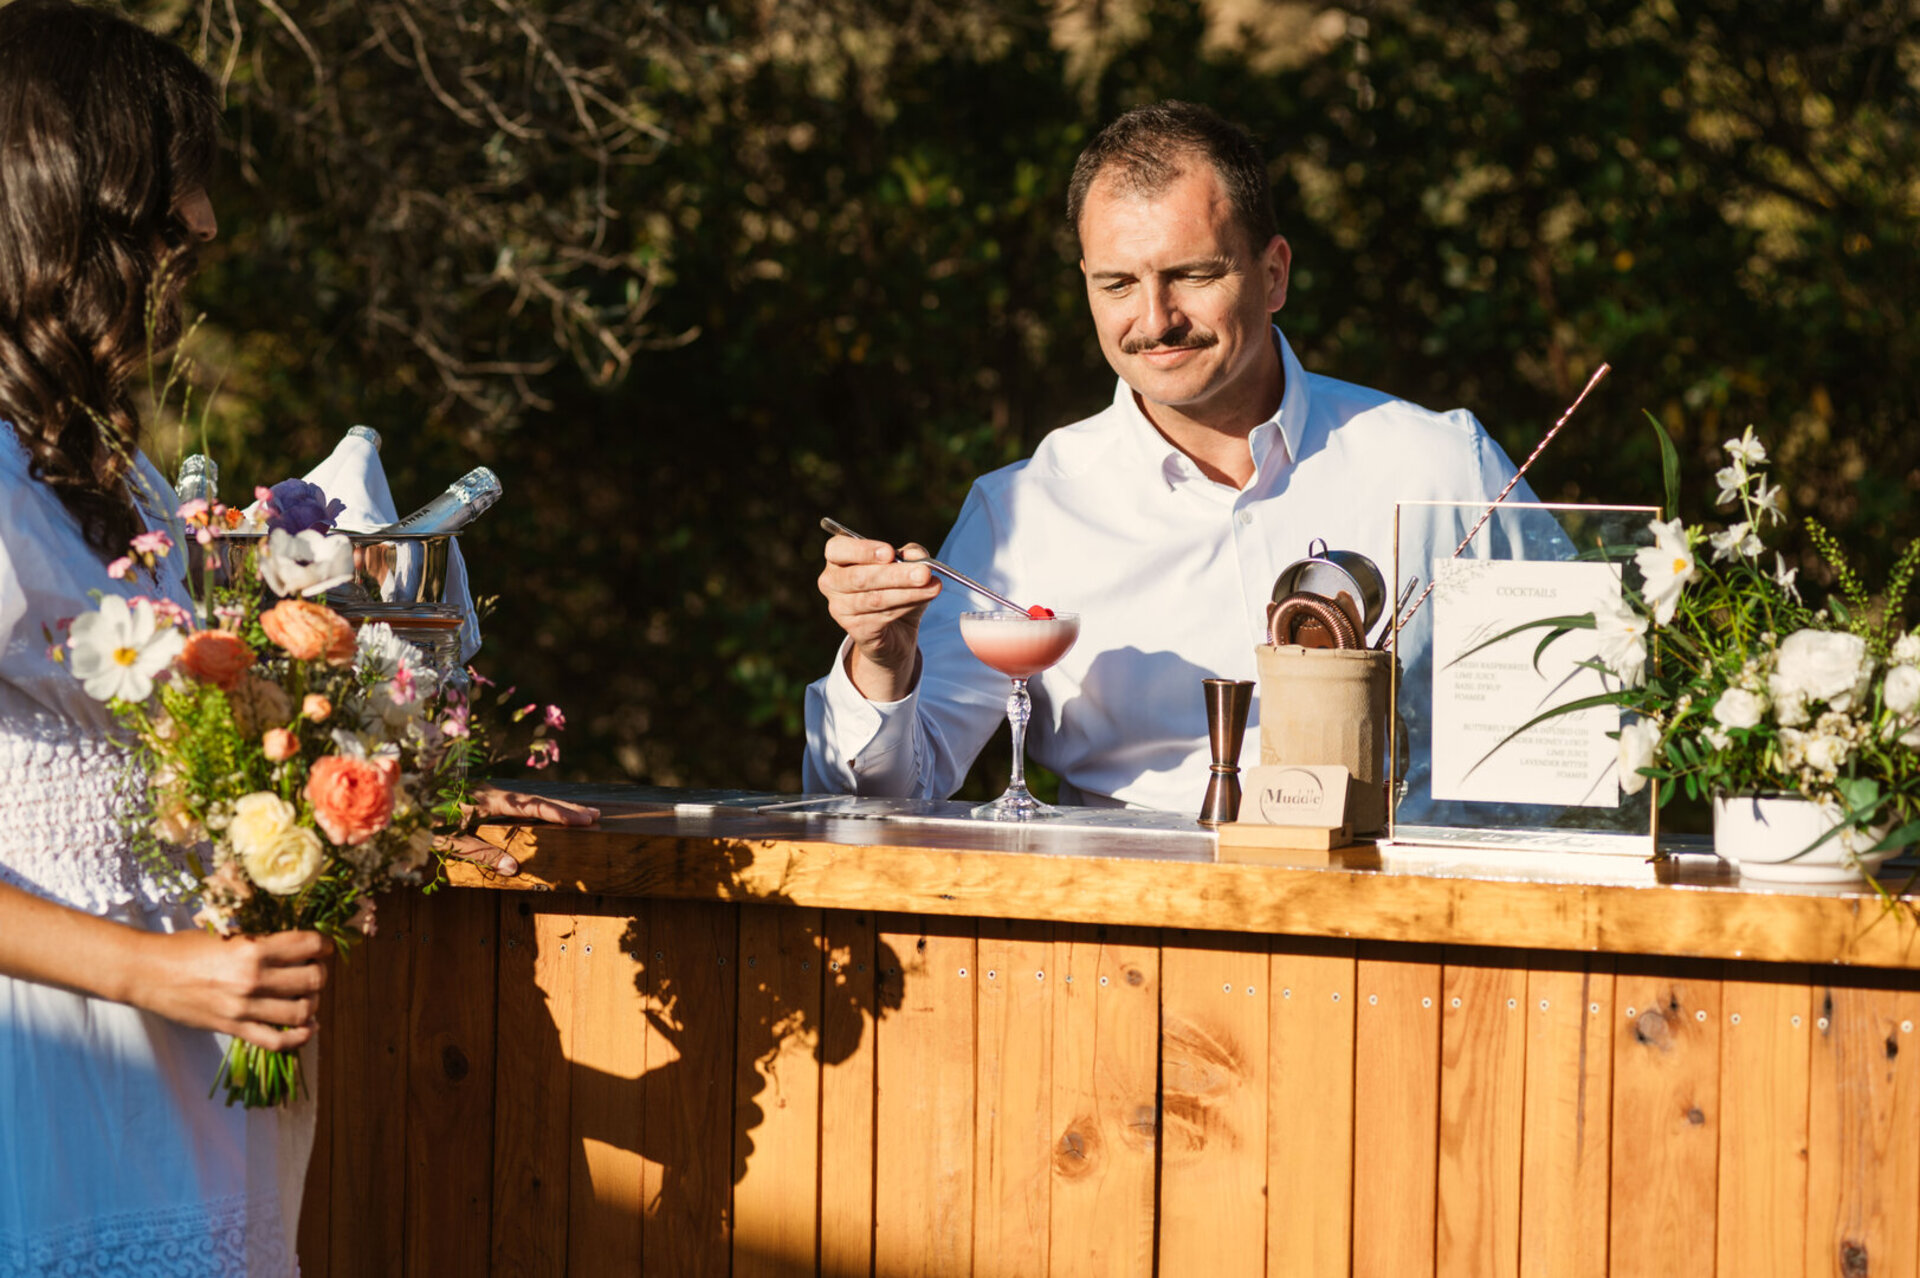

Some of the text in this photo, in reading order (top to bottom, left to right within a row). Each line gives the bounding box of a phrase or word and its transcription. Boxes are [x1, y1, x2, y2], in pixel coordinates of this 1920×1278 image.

[1496, 586, 1558, 598] COCKTAILS
[1520, 758, 1559, 768] LAVENDER
[1264, 788, 1321, 804] Muddle
